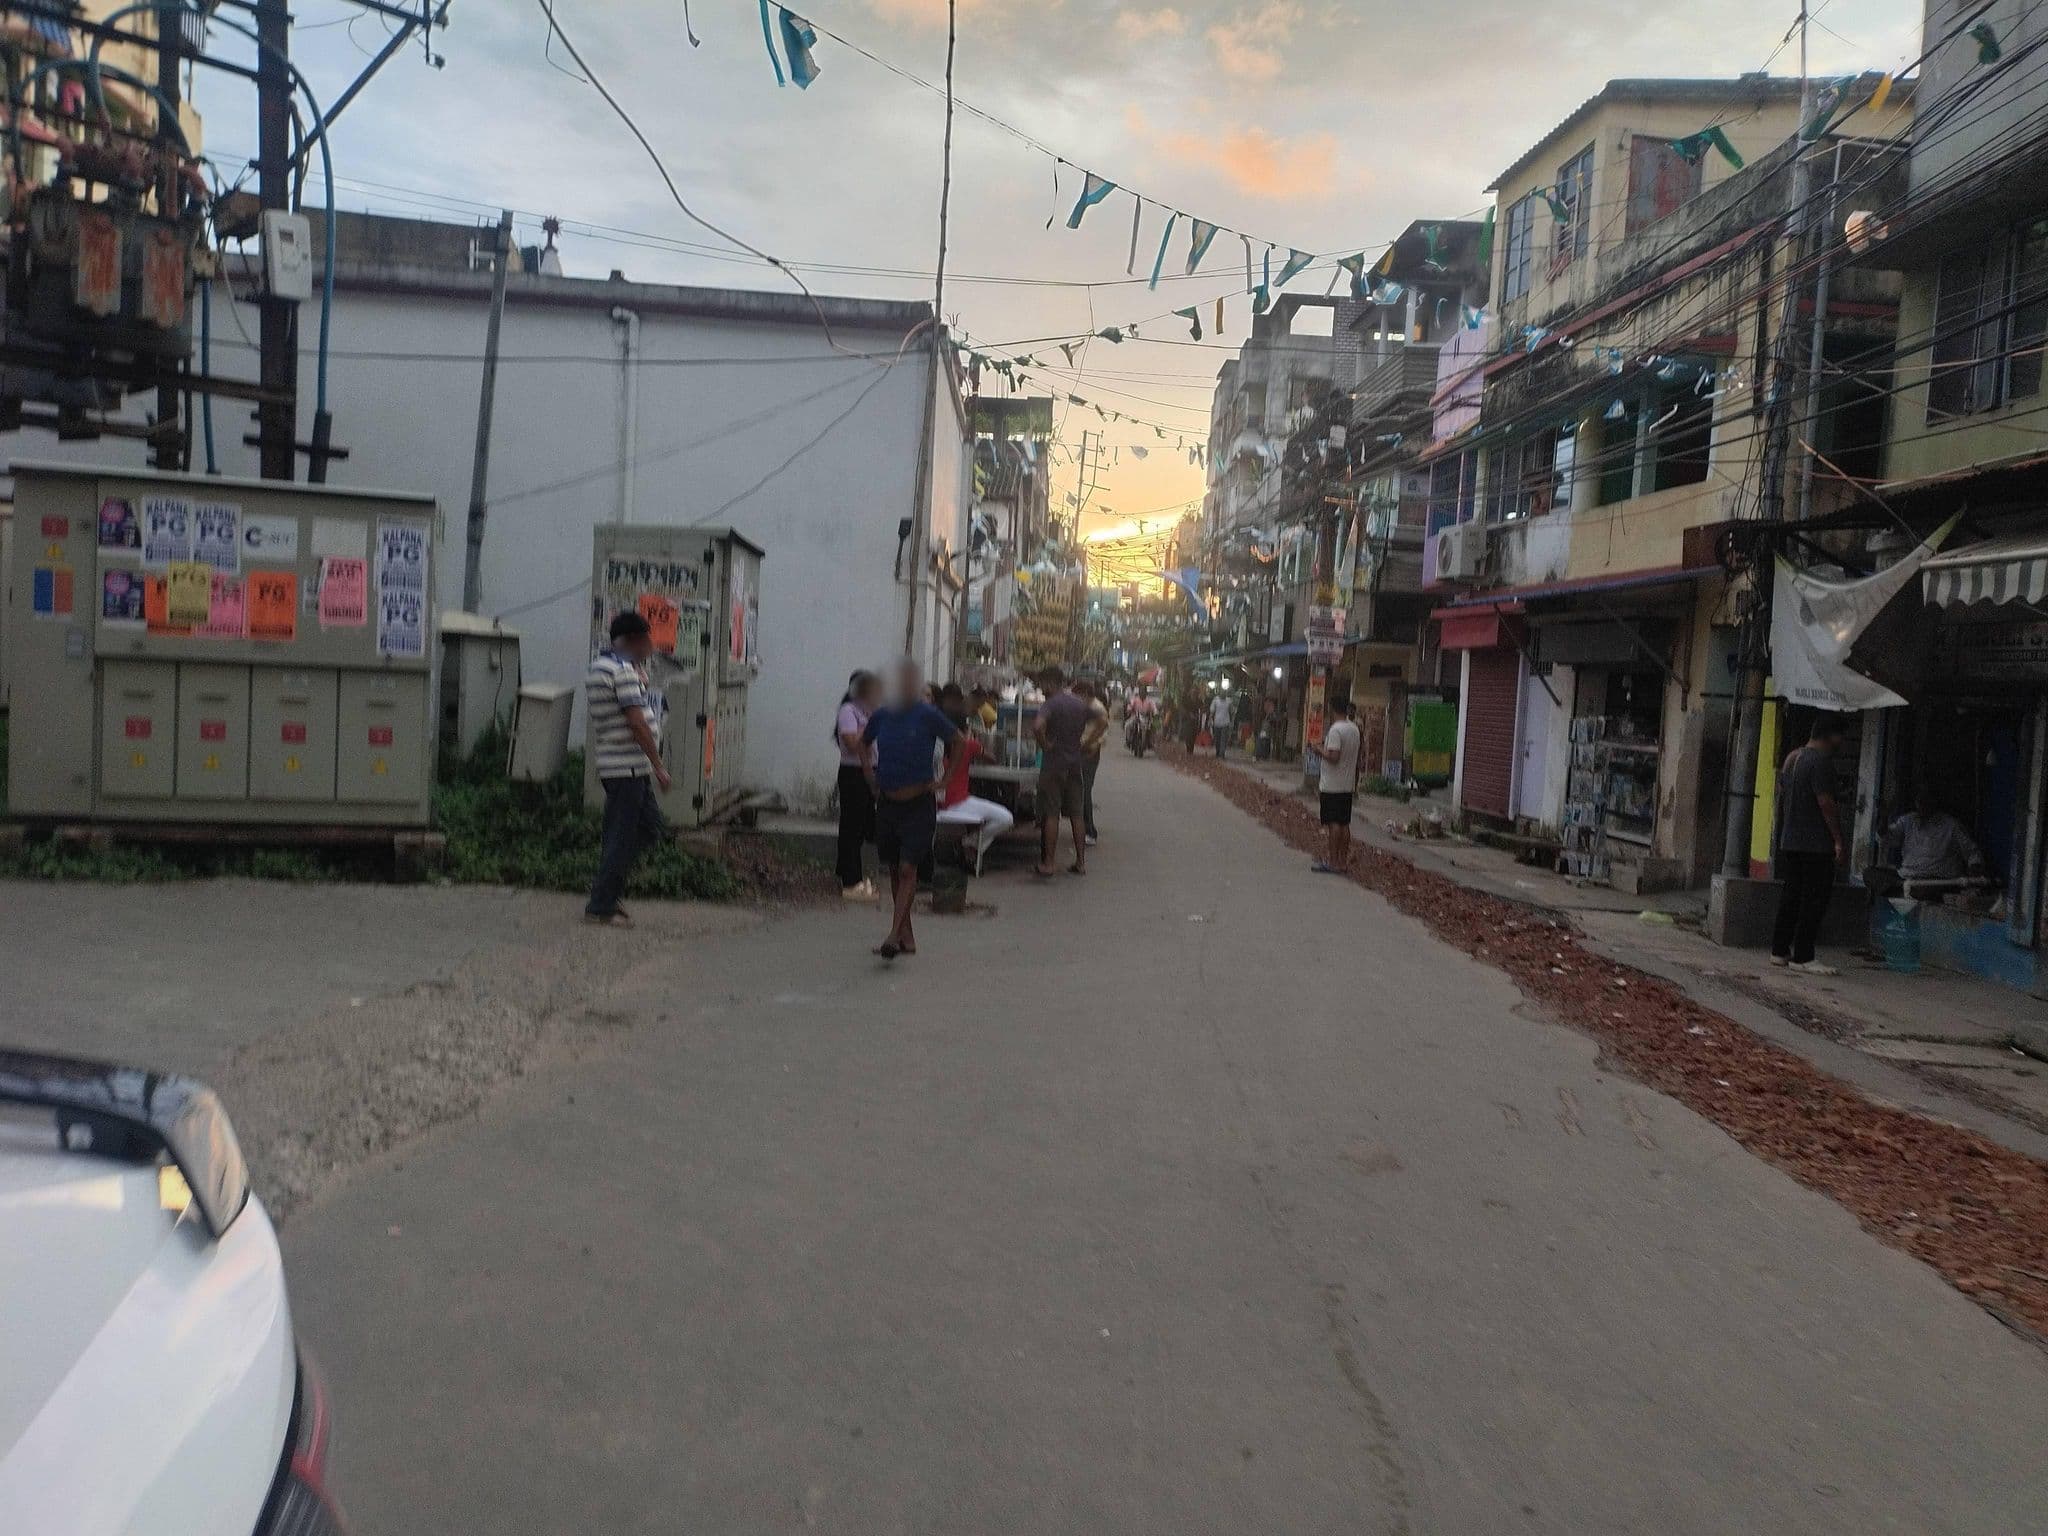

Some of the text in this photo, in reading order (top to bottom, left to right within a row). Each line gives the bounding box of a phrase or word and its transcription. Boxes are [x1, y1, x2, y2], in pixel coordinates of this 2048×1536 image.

[147, 499, 188, 517] KALPANA
[196, 506, 236, 524] KALPANA
[152, 515, 186, 537] PG
[200, 522, 235, 543] PG
[383, 527, 421, 546] KALPANA
[387, 544, 420, 565] PG
[259, 582, 287, 602] PG
[383, 591, 421, 609] KALPANA
[387, 607, 420, 627] PG
